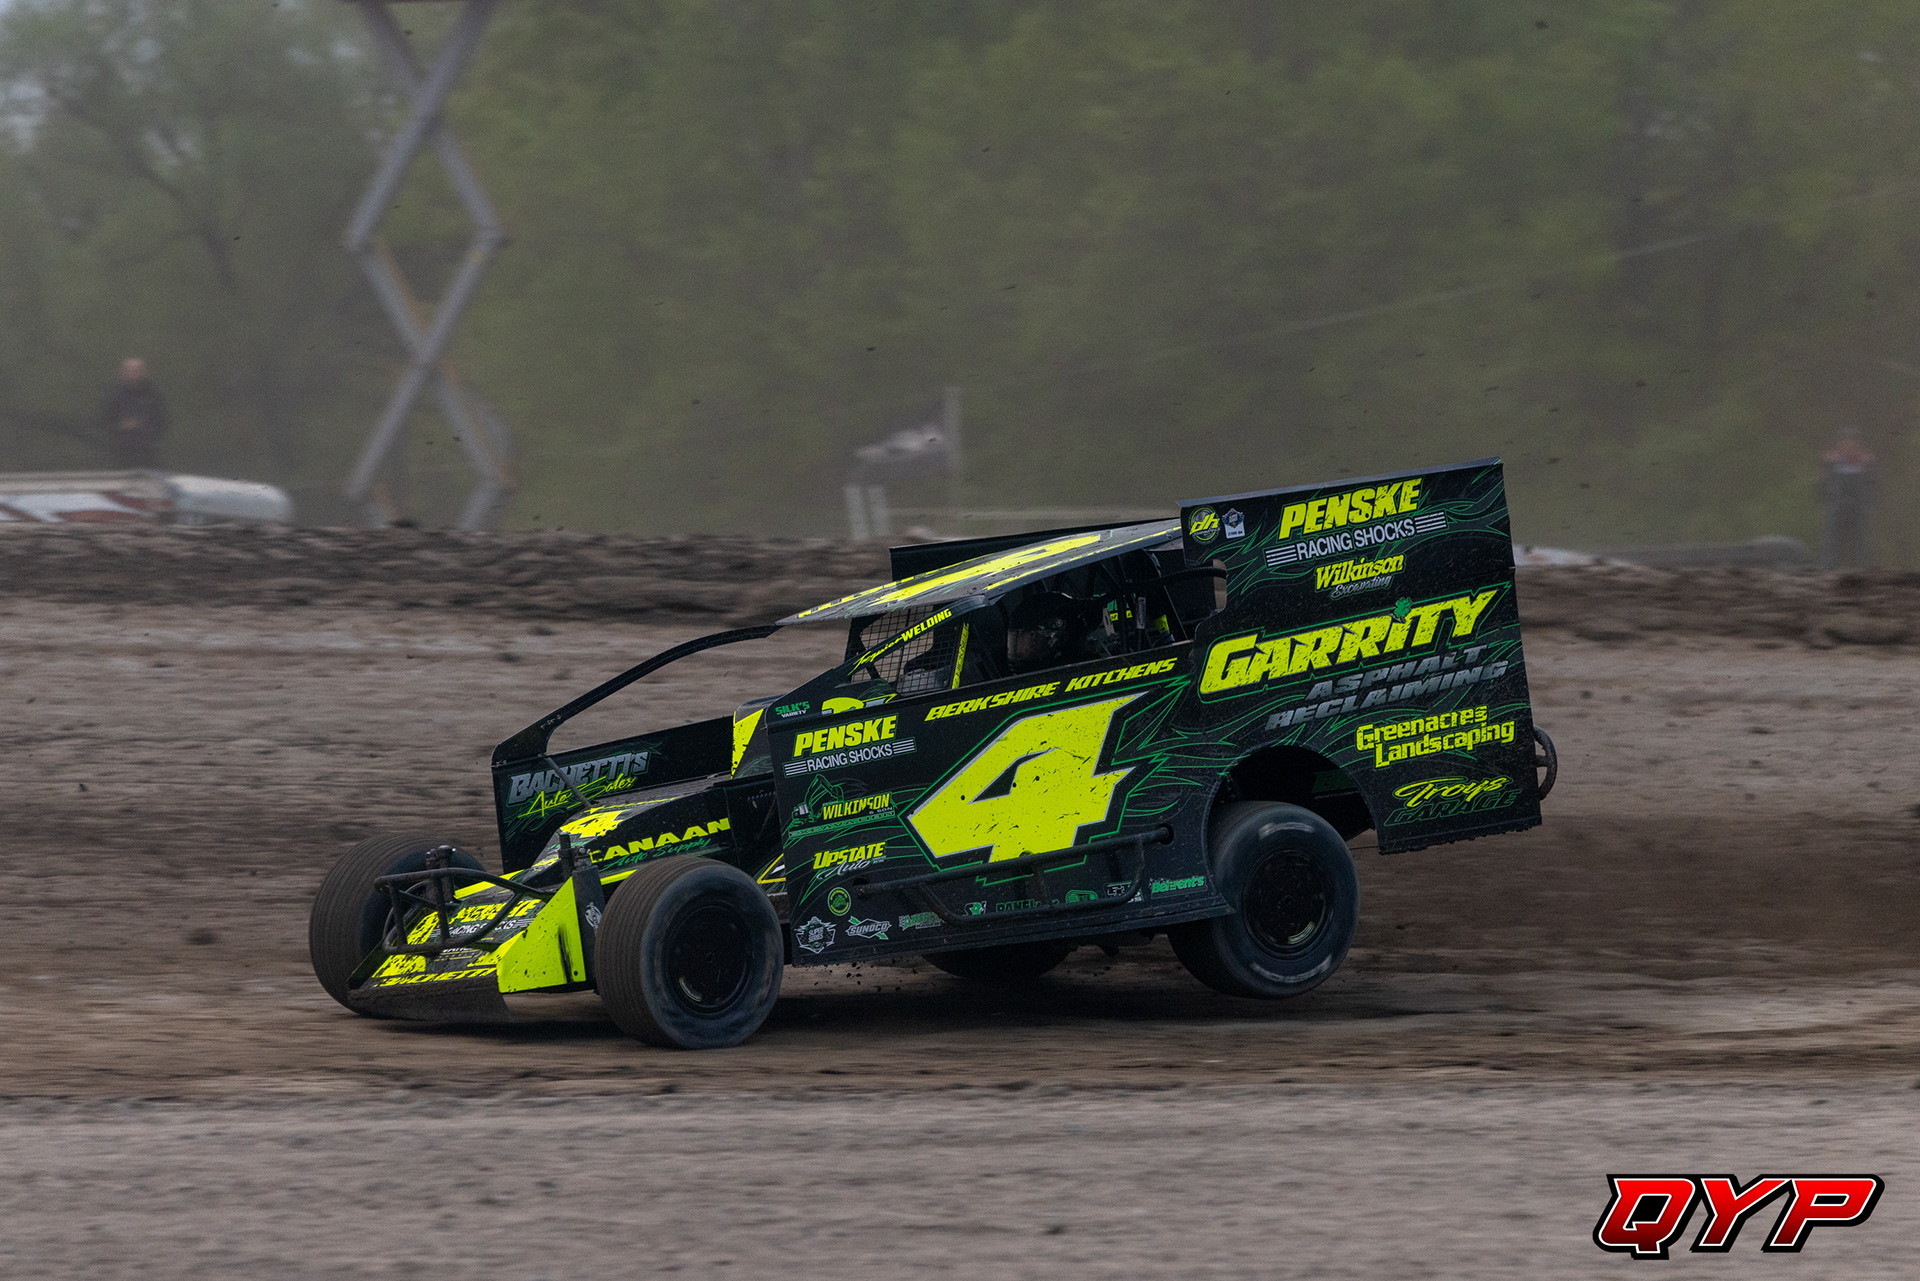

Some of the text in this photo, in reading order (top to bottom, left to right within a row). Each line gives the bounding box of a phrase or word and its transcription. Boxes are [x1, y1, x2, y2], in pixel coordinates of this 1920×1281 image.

[1278, 478, 1423, 540] PENSKE
[1297, 518, 1416, 561] RACING SHOCKS
[1315, 554, 1404, 590] Wilkinson
[1330, 575, 1393, 598] Excavating
[901, 608, 952, 642] WELDING
[1199, 588, 1499, 695] GARRITY
[924, 657, 1178, 722] BERKSHIRE KITCHENS
[1305, 644, 1488, 700] ASPHALT
[775, 701, 810, 715] SILK'S
[781, 709, 807, 718] VARIETY
[1264, 660, 1509, 731] RECLAIMING
[794, 715, 897, 757] PENSKE
[1356, 705, 1488, 751] Greenacres
[1375, 721, 1515, 768] Landscaping
[508, 751, 649, 804] BACHETTI'S
[807, 743, 893, 772] RACING SHOCKS
[907, 690, 1150, 864] 4
[518, 788, 572, 818] Auto
[571, 772, 637, 808] Sales
[823, 793, 890, 820] WILKINSON
[589, 817, 731, 864] CANAAN
[600, 852, 649, 872] Auto
[652, 838, 712, 858] Supply
[813, 841, 886, 870] UPSTATE
[816, 858, 871, 880] Auto
[849, 923, 889, 935] SUNOCO
